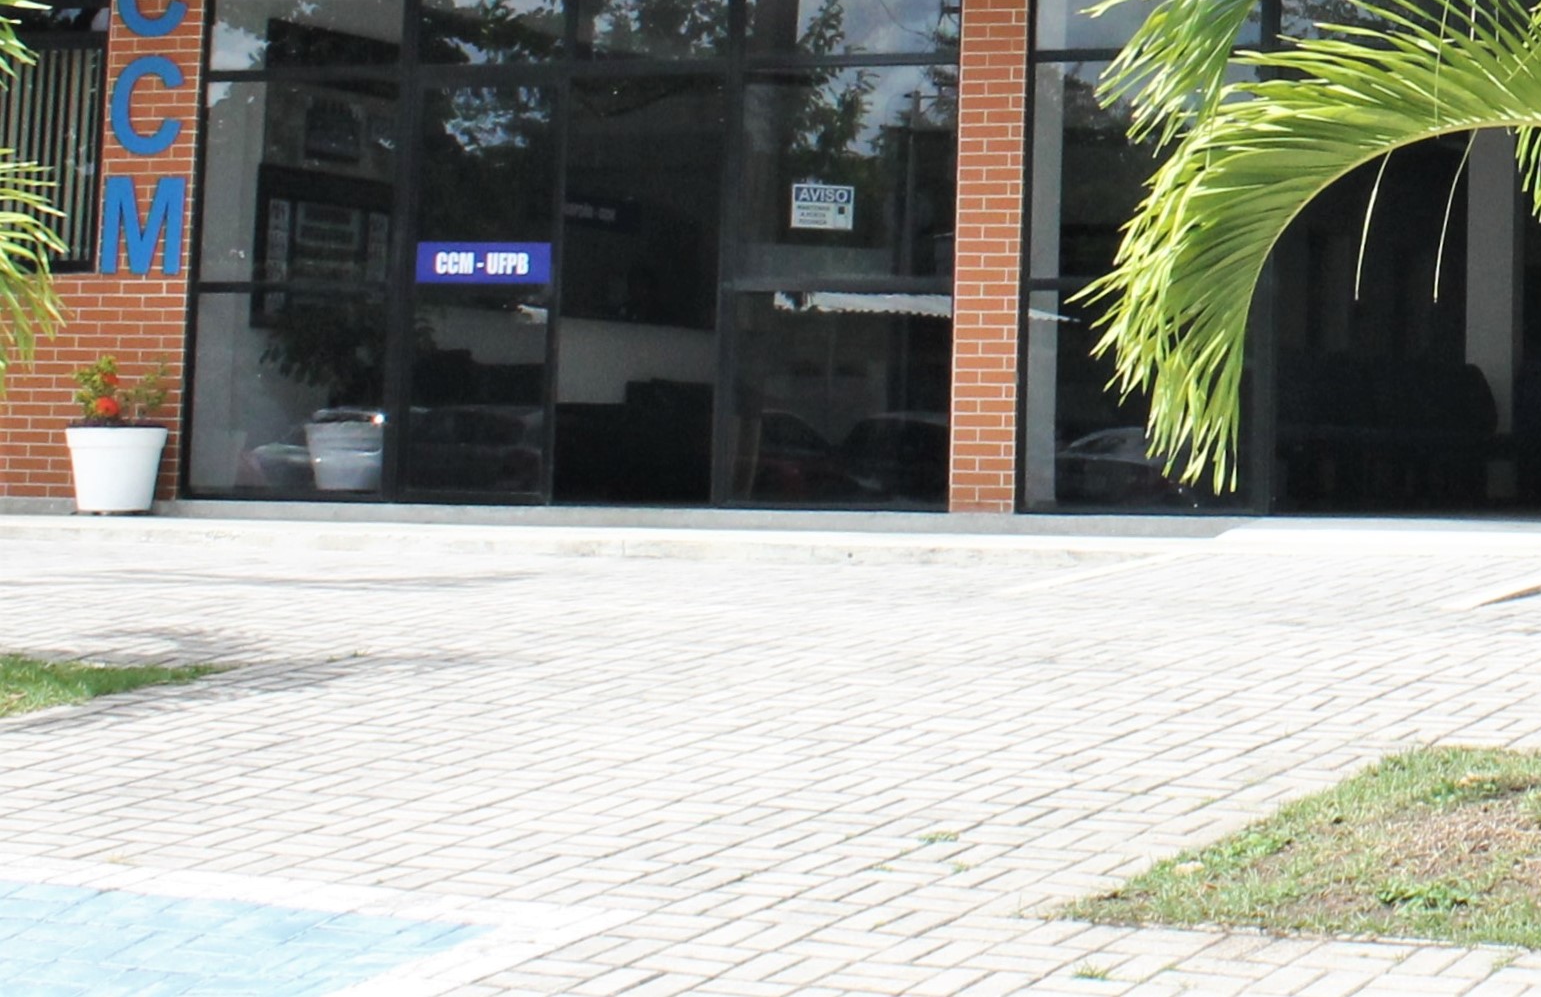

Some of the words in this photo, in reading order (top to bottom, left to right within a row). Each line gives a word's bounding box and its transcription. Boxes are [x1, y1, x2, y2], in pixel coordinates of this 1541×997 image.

[799, 188, 848, 203] AVISO
[435, 251, 475, 275] CCM
[486, 252, 530, 275] UFPB
